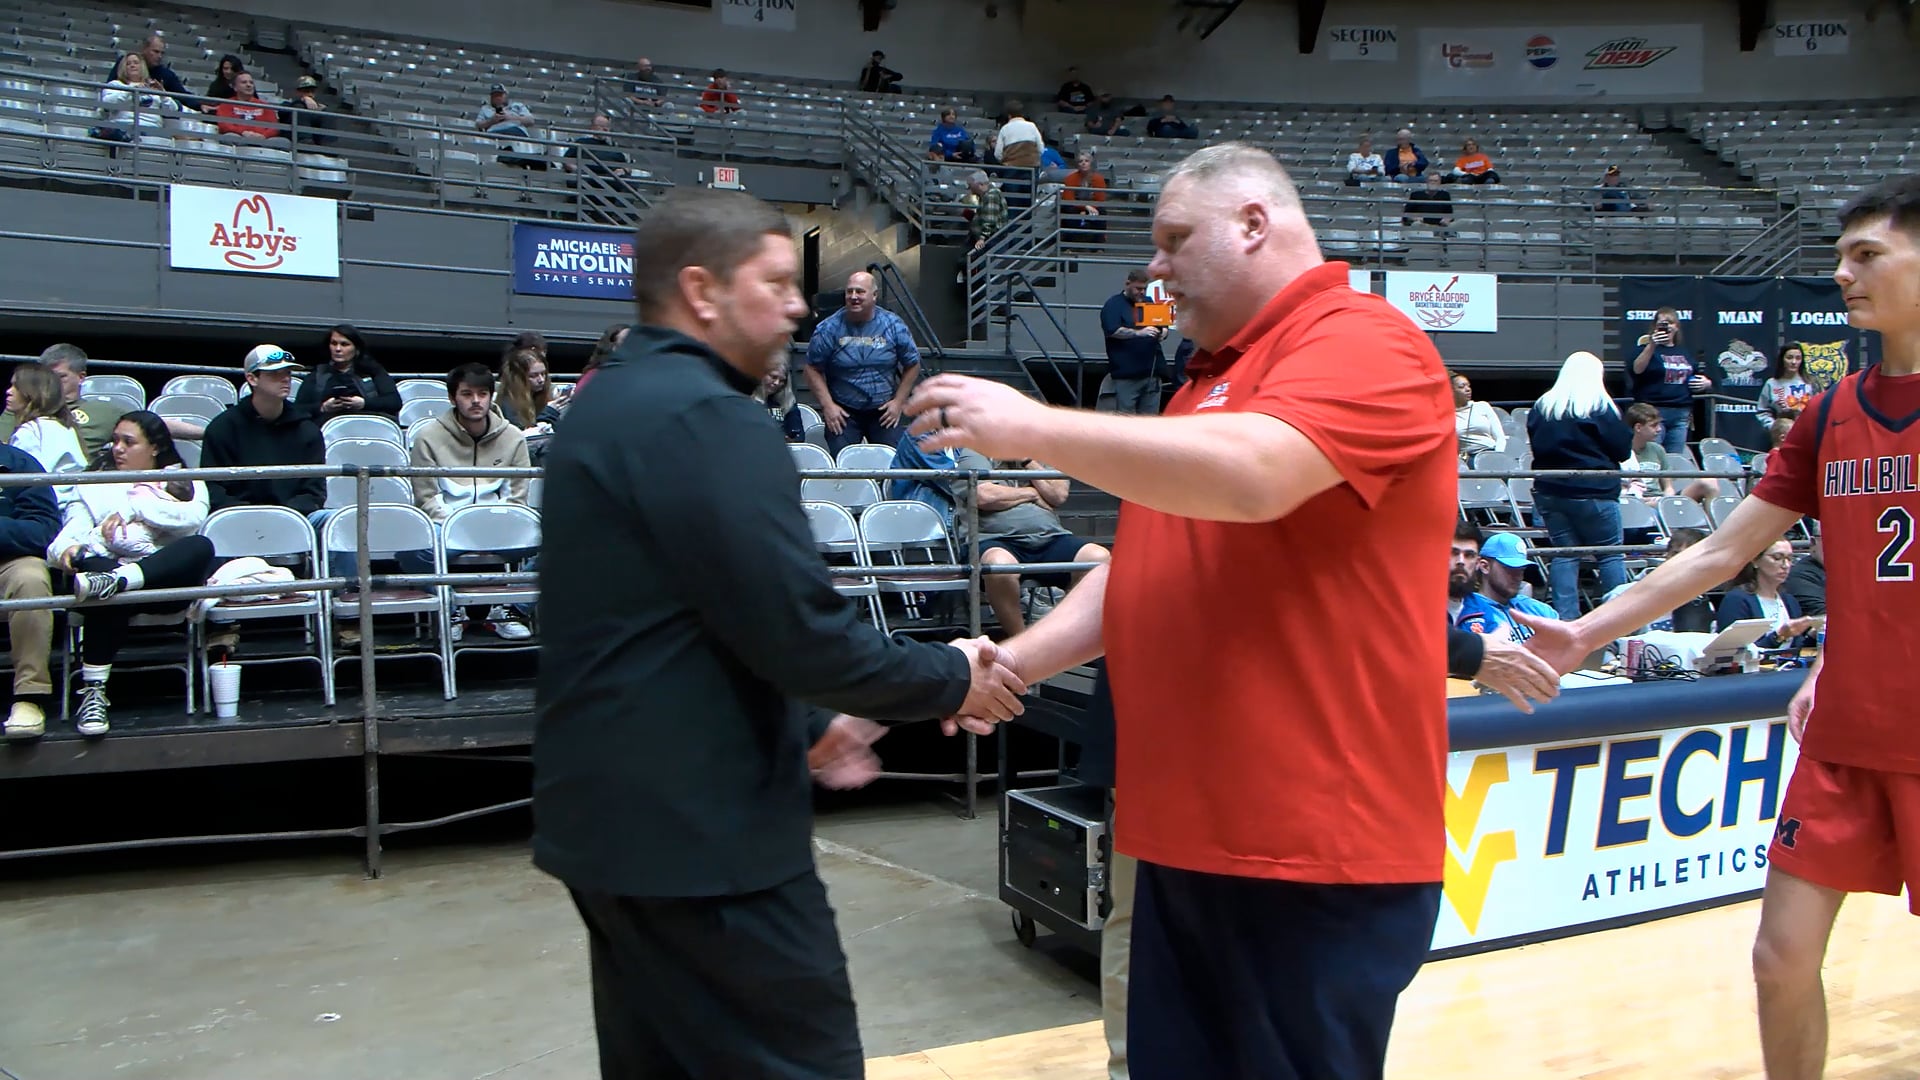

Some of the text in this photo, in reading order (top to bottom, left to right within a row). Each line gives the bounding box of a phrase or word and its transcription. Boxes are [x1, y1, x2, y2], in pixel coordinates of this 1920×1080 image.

[754, 8, 764, 22] 4
[1330, 28, 1397, 43] SECTION
[1775, 22, 1847, 38] SECTION
[1359, 43, 1369, 56] 5
[1806, 37, 1817, 51] 6
[718, 168, 735, 183] EXIT
[209, 223, 297, 257] Arby's
[550, 238, 617, 255] MICHAEL
[534, 273, 578, 284] STATE
[1409, 291, 1470, 303] BRYCE RADFORD
[1718, 311, 1763, 325] MAN
[1790, 311, 1849, 325] LOGAN
[1823, 454, 1920, 498] HILLBIL
[1876, 506, 1915, 581] 2
[1533, 721, 1789, 859] TECH
[1582, 844, 1767, 900] ATHLETICS
